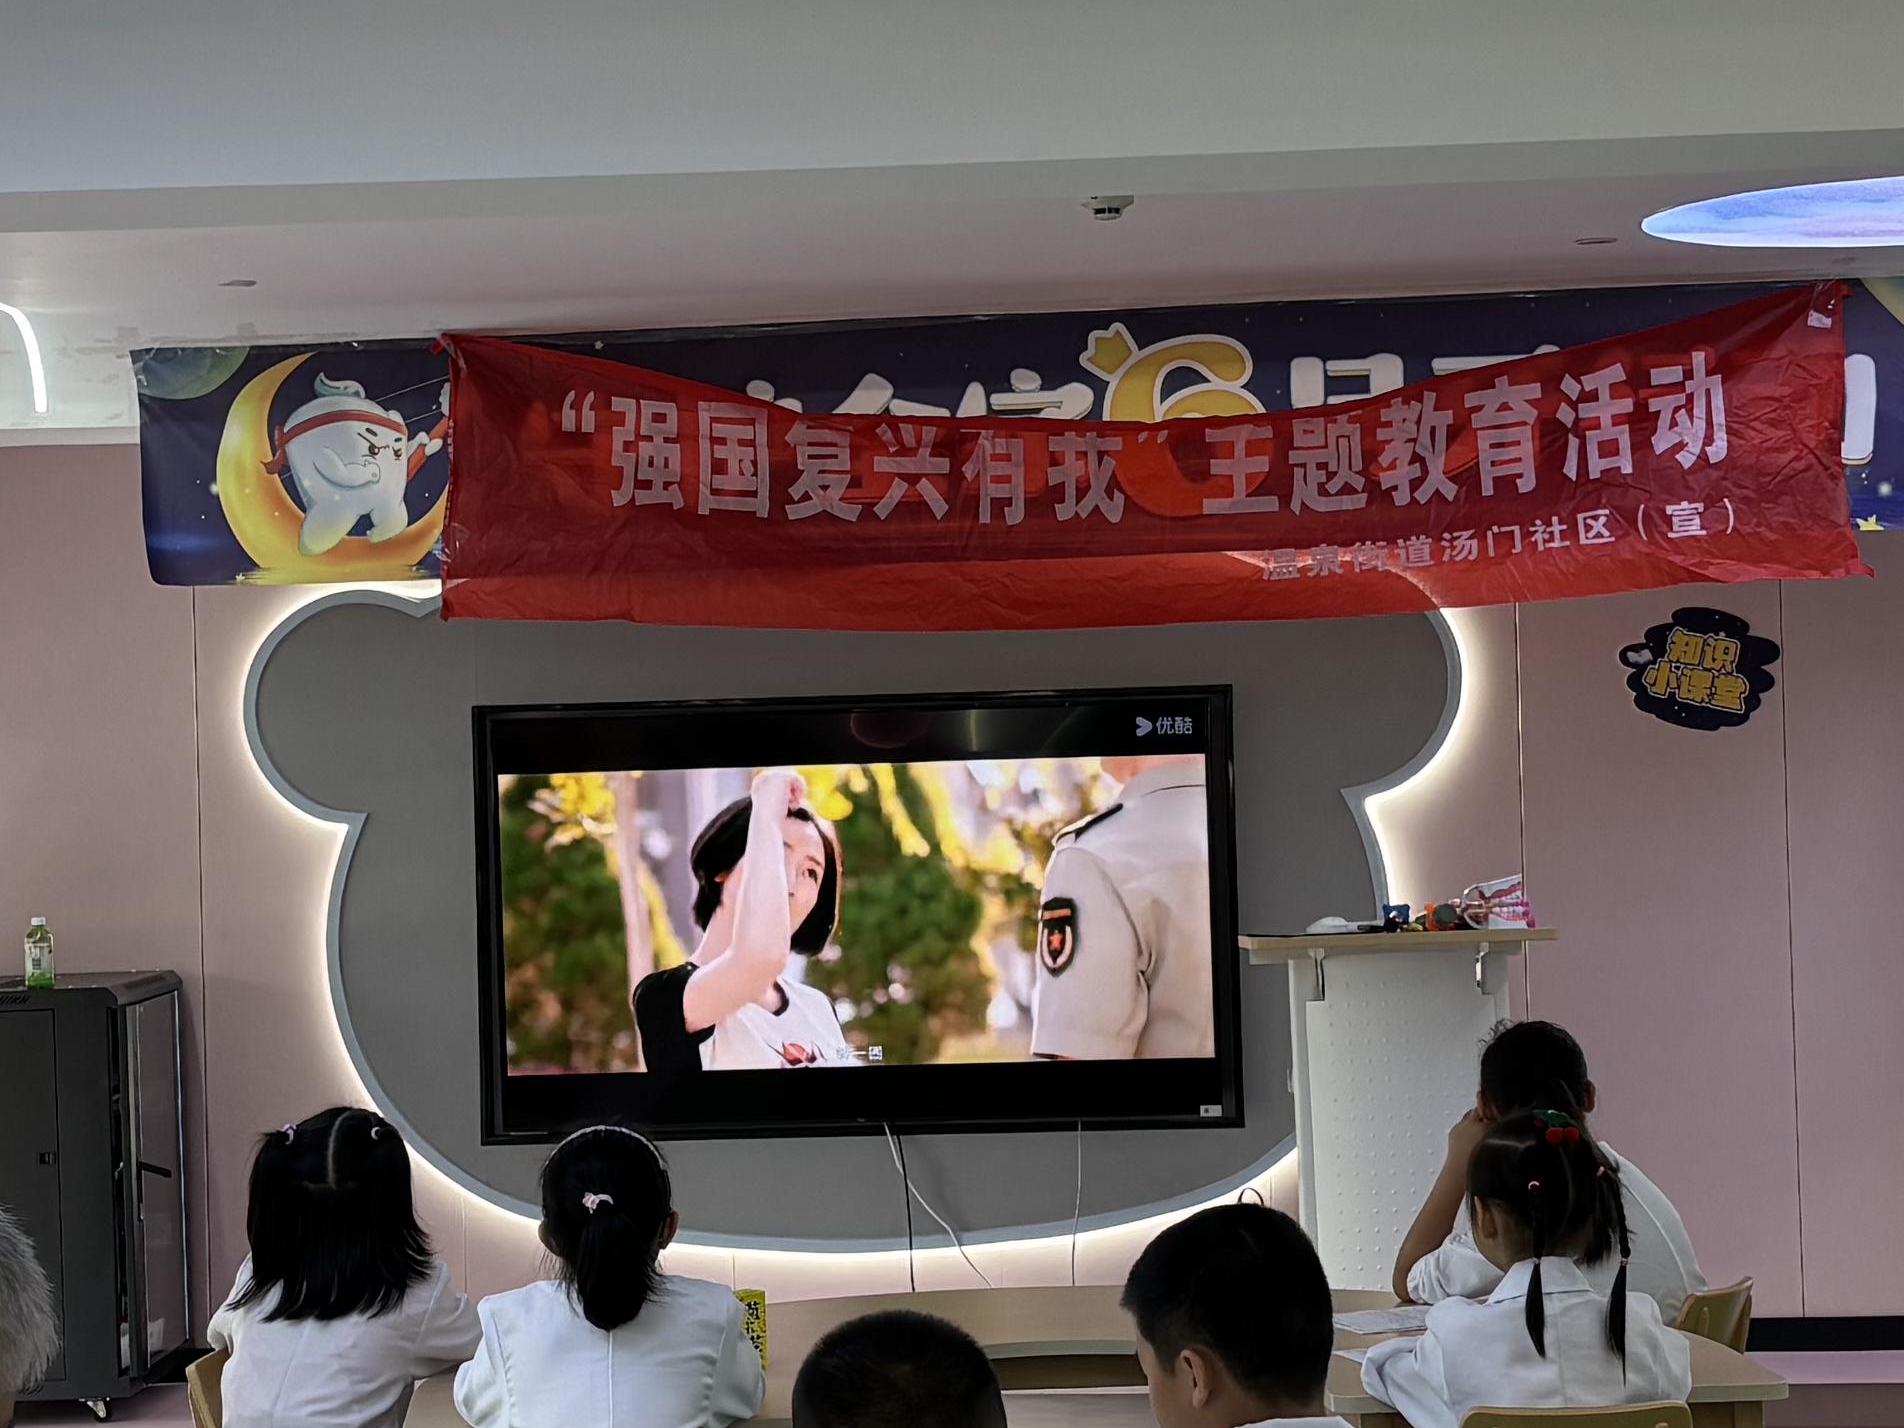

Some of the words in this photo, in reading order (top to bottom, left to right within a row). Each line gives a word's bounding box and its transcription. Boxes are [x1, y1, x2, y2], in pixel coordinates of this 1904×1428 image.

[1667, 628, 1739, 674] 知识
[1643, 658, 1748, 712] 小课堂
[1156, 716, 1193, 735] 优酷
